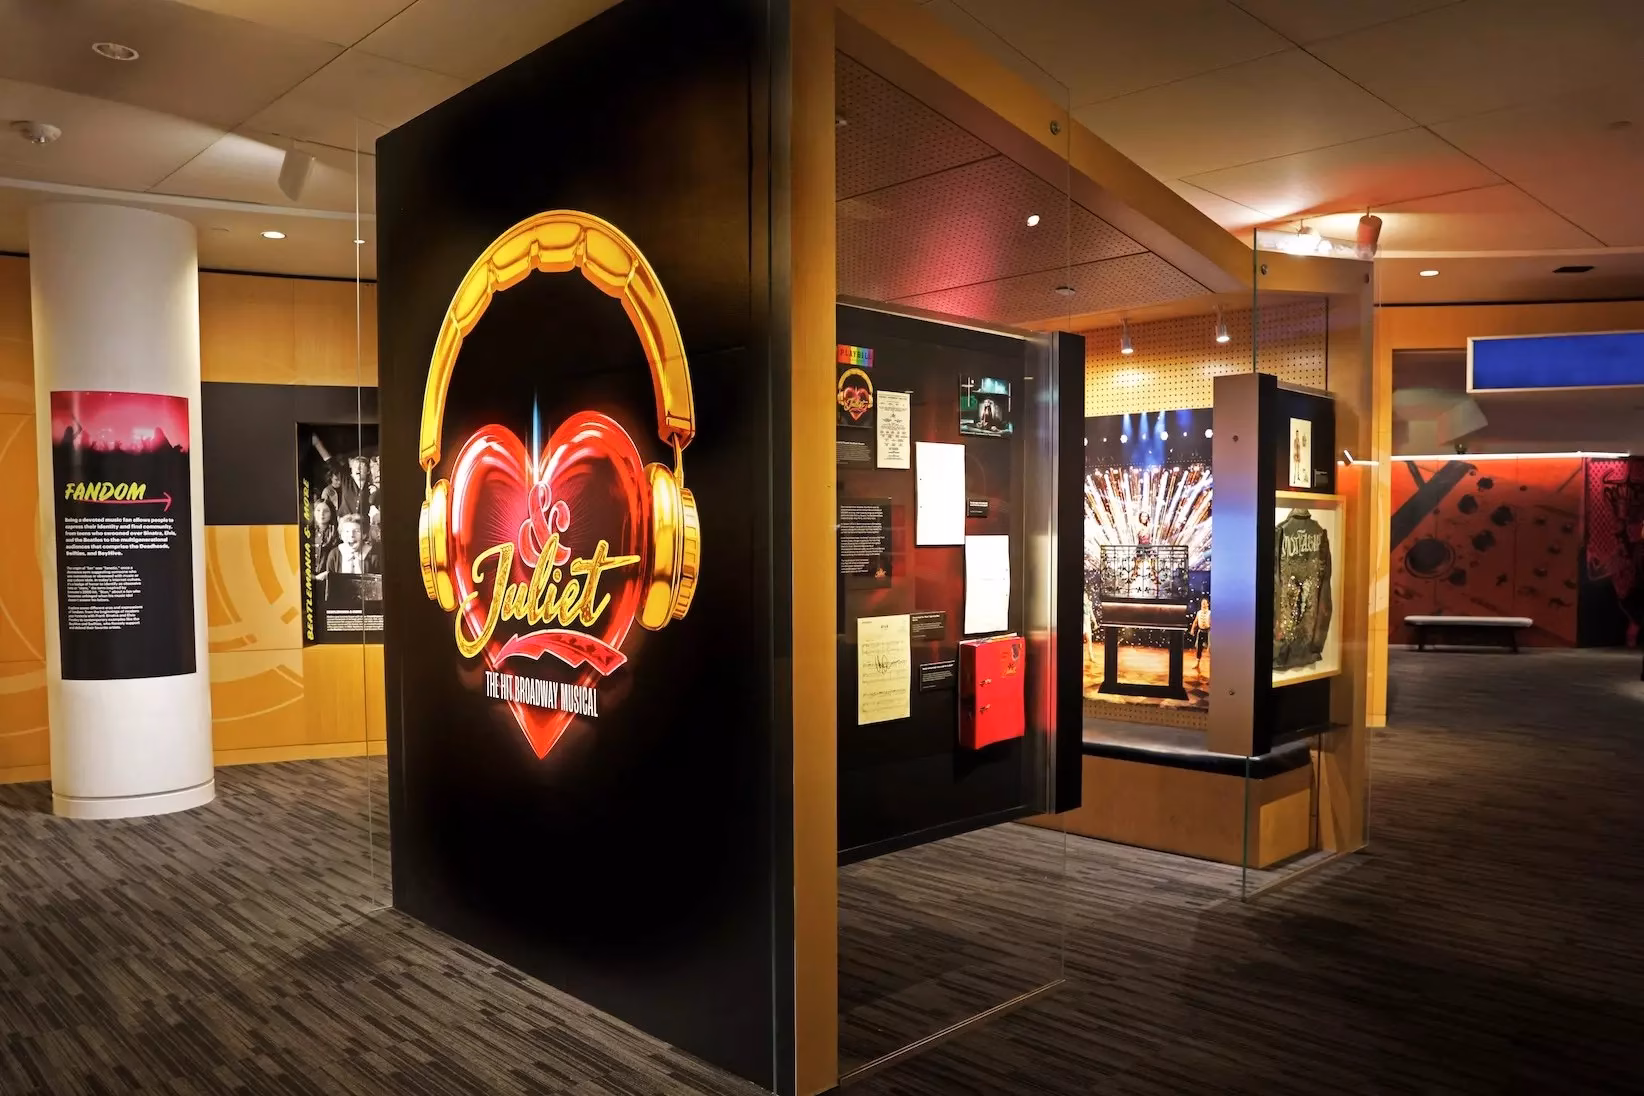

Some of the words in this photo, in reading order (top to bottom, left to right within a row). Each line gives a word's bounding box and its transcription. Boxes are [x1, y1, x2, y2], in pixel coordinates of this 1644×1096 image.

[65, 481, 147, 502] FANDOM
[303, 478, 311, 521] MORE
[304, 542, 315, 641] BEATLEMANIA
[455, 531, 641, 658] Juliet
[485, 671, 500, 699] THE
[500, 674, 513, 702] HIT
[515, 676, 558, 710] BROADWAY
[560, 683, 599, 718] MUSICAL
